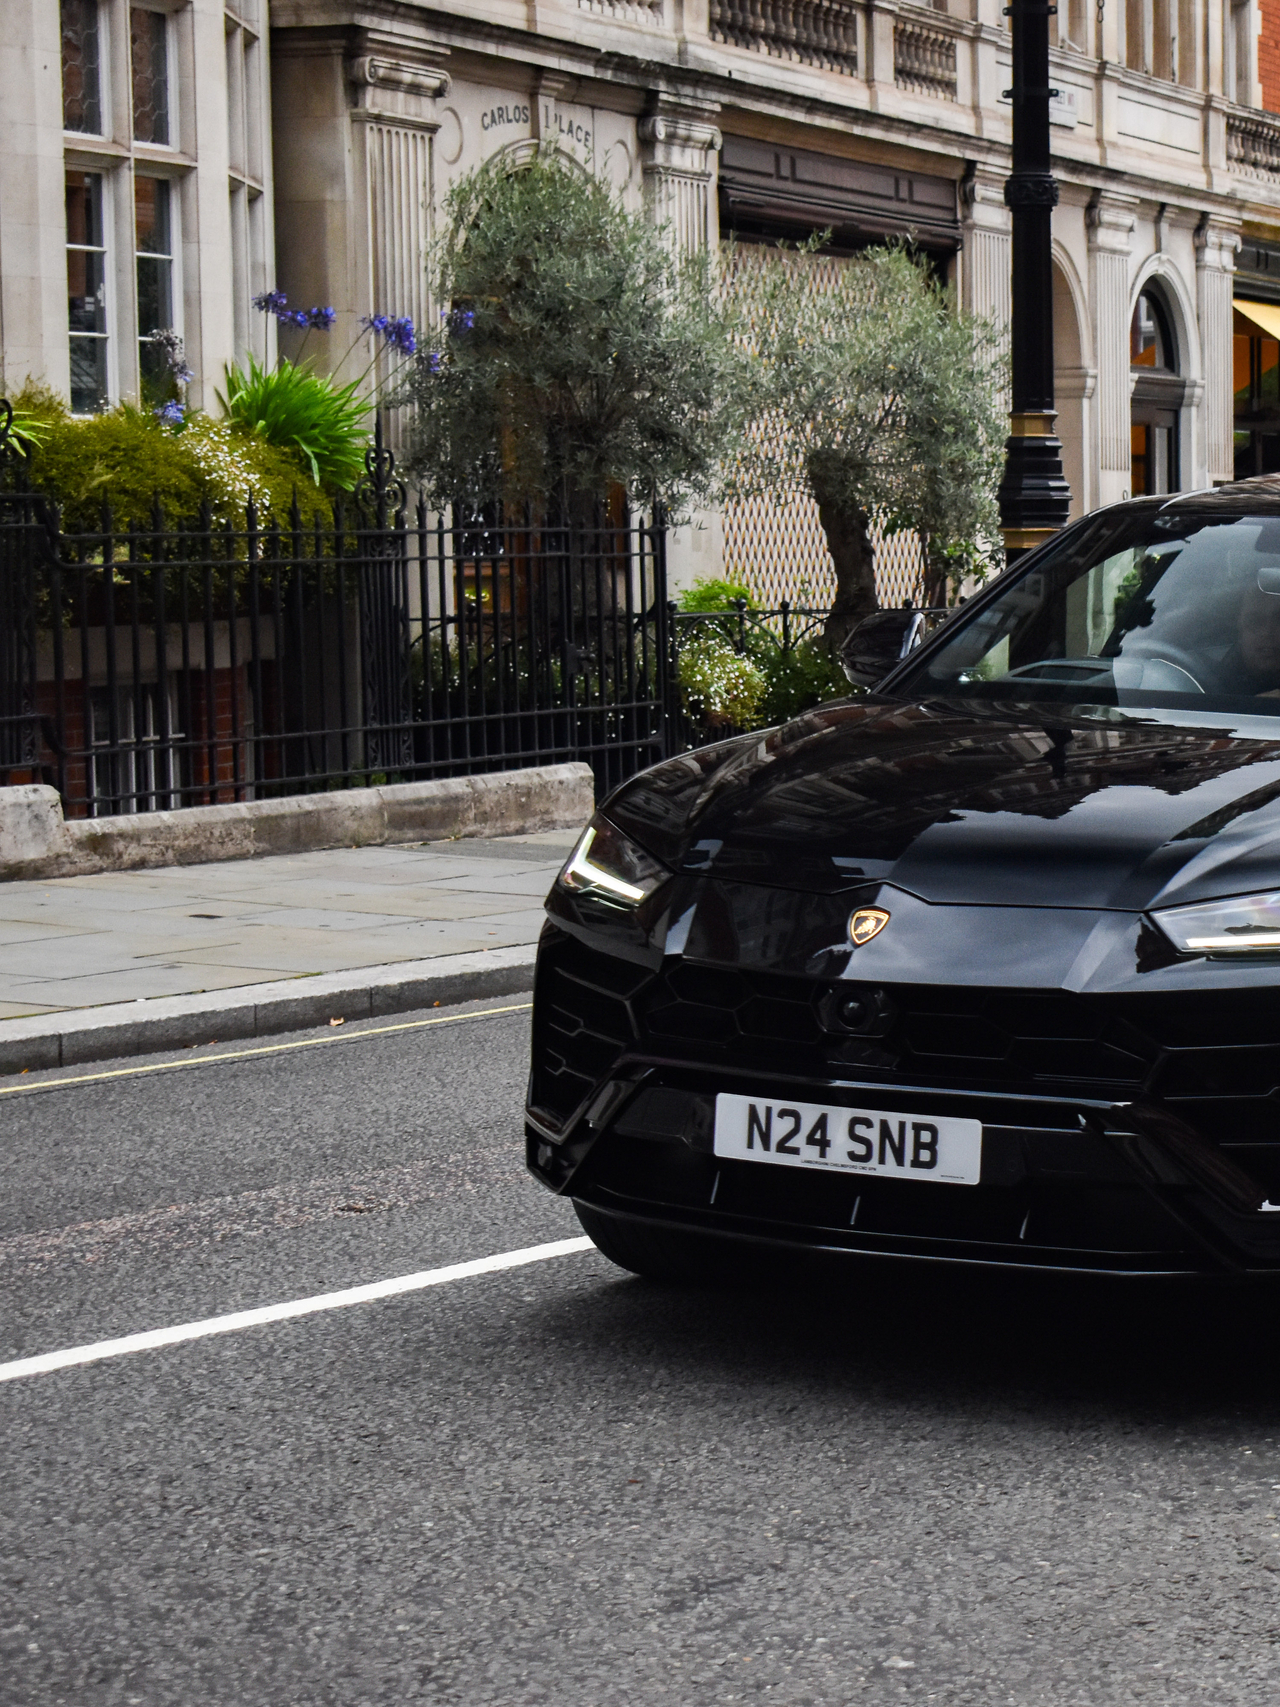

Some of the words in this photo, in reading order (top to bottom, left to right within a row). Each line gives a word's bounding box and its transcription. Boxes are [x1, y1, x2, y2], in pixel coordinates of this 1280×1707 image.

[481, 105, 529, 131] CARLOS
[747, 1103, 831, 1159] N24
[847, 1116, 939, 1170] SNB
